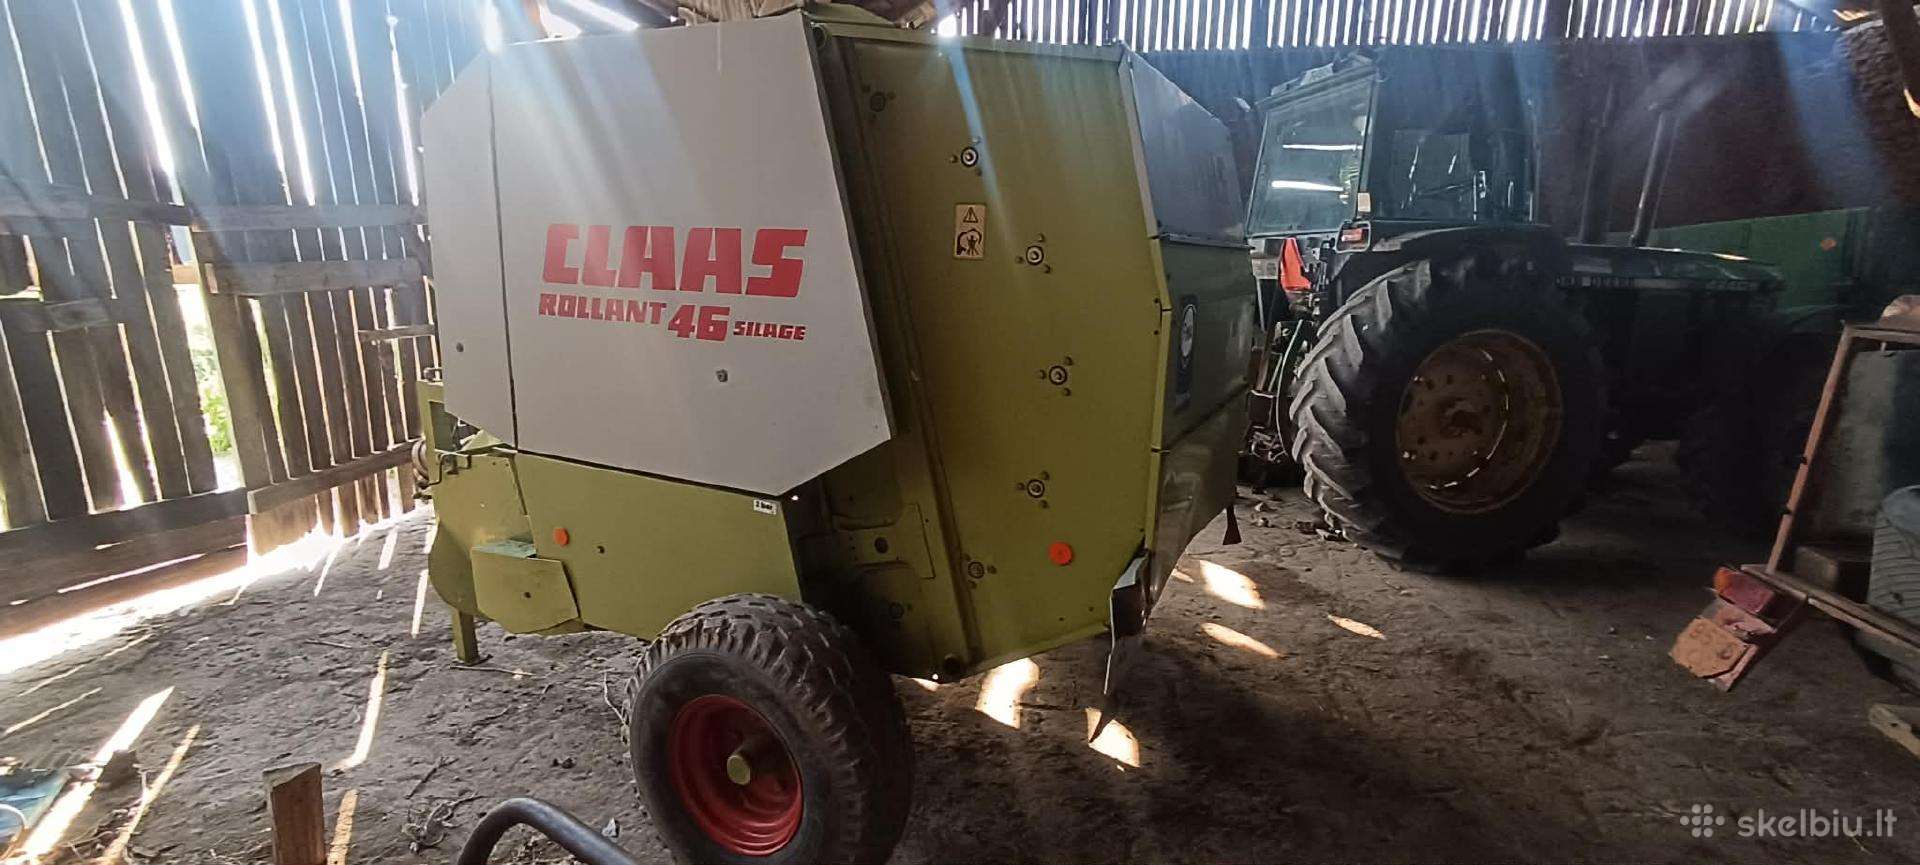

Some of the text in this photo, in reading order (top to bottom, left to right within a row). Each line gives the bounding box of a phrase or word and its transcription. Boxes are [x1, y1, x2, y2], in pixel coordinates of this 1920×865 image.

[543, 223, 808, 298] CLAAS
[539, 293, 806, 341] ROLLANT 46 SILAGE
